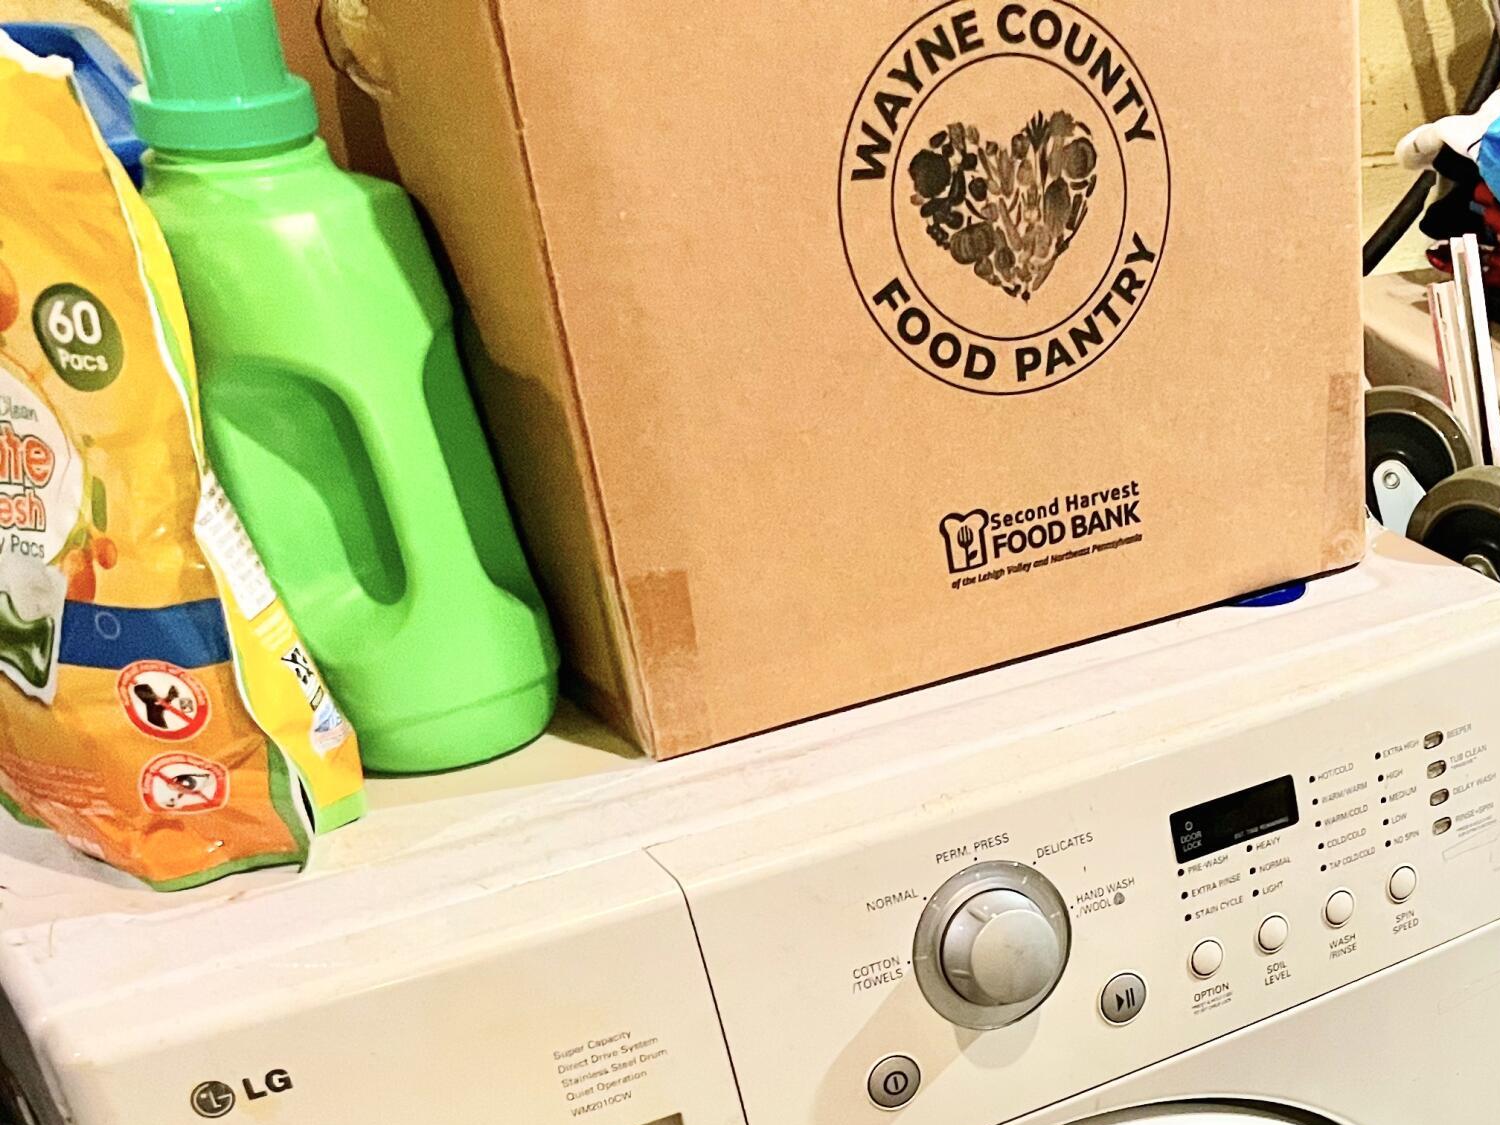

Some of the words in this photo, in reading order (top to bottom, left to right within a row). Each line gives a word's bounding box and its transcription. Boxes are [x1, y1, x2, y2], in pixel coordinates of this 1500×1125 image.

[851, 10, 985, 183] WAYNE
[997, 4, 1157, 145] COUNTY
[873, 277, 996, 380] FOOD
[1015, 231, 1157, 381] PANTRY
[48, 299, 102, 346] 60
[57, 349, 108, 372] Pacs
[0, 488, 45, 531] esh
[990, 497, 1059, 530] Second
[1066, 480, 1139, 512] Harvest
[993, 520, 1066, 558] FOOD
[1071, 501, 1142, 538] BANK
[11, 534, 44, 558] Pacs
[952, 578, 961, 589] of
[962, 574, 976, 586] the
[978, 568, 1005, 583] Lehigh
[1007, 560, 1032, 575] Valley
[1033, 556, 1049, 567] and
[1050, 547, 1091, 564] Northeast
[1091, 534, 1143, 553] Pennsylvania
[1382, 745, 1403, 758] EXTRA
[1450, 752, 1463, 763] TUB
[1464, 744, 1487, 758] CLEAN
[1318, 762, 1354, 781] HOT/COLD
[1386, 768, 1403, 780] HIGH
[1321, 781, 1368, 803] WARM/WARM
[1389, 786, 1417, 802] MEDIUM
[1452, 782, 1475, 796] DELAY
[1476, 772, 1497, 786] WASH
[1324, 804, 1369, 826] WARM/COLD
[1391, 812, 1408, 824] LOW
[1036, 832, 1094, 859] DELICATES
[1180, 831, 1202, 844] DOOR
[1183, 840, 1202, 853] LOCK
[1256, 836, 1281, 851] HEAVY
[1326, 827, 1367, 849] COLD/COLD
[1394, 836, 1404, 846] NO
[1404, 830, 1420, 841] SPIN
[935, 846, 971, 865] PERM.
[973, 833, 1010, 852] PRESS
[1329, 859, 1341, 870] TAP
[1342, 846, 1376, 865] COLD/COLD
[1187, 854, 1229, 874] PRE-WASH
[1259, 857, 1291, 873] NORMAL
[1076, 884, 1105, 905] HAND
[1106, 877, 1136, 897] WASH
[1191, 882, 1217, 898] EXTRA
[1218, 873, 1241, 888] RINSE
[1262, 880, 1284, 896] LIGHT
[866, 888, 919, 912] NORMAL
[1077, 899, 1112, 917] /WOOL
[1195, 904, 1219, 920] STAIN
[1220, 895, 1244, 911] CYCLE
[1392, 917, 1420, 935] SPEED
[1395, 910, 1415, 924] SPIN
[1329, 933, 1356, 950] WASH
[1329, 942, 1358, 960] /RINSE
[852, 956, 901, 980] COTTON
[1264, 969, 1291, 986] LEVEL
[1266, 960, 1287, 975] SOIL
[852, 969, 904, 994] /TOWELS
[1194, 982, 1229, 1002] OPTION
[553, 1045, 584, 1060] Super
[587, 1031, 631, 1049] Capacity
[557, 1059, 589, 1074] Direct
[590, 1050, 618, 1063] Drive
[620, 1037, 658, 1054] System
[561, 1068, 609, 1088] Stainless
[611, 1057, 637, 1072] Steel
[639, 1049, 668, 1063] Drum
[242, 1069, 293, 1100] LG
[566, 1087, 594, 1101] Quiet
[596, 1070, 648, 1091] Operation
